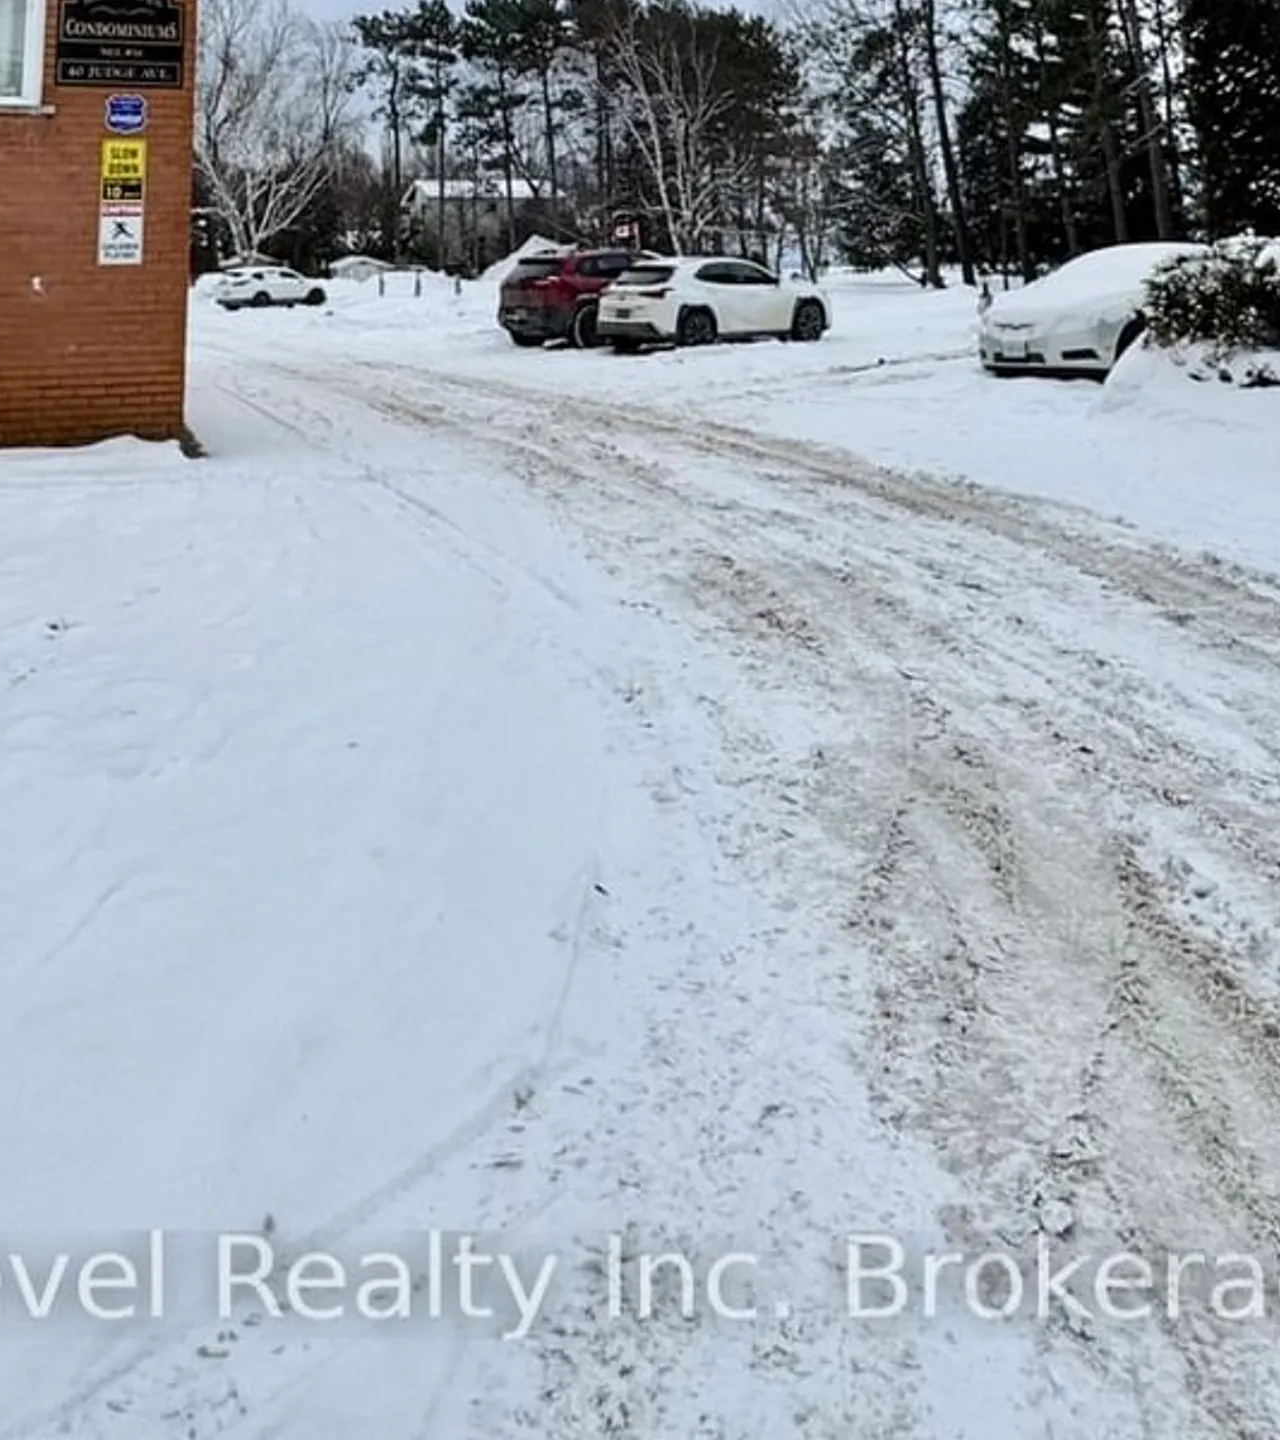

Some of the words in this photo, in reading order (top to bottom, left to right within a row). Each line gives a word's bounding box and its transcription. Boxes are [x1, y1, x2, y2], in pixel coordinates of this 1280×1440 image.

[66, 18, 176, 39] CONDOMINIUMS
[87, 66, 133, 78] JUDGE
[110, 146, 139, 160] SLOW
[108, 163, 140, 175] DOWN
